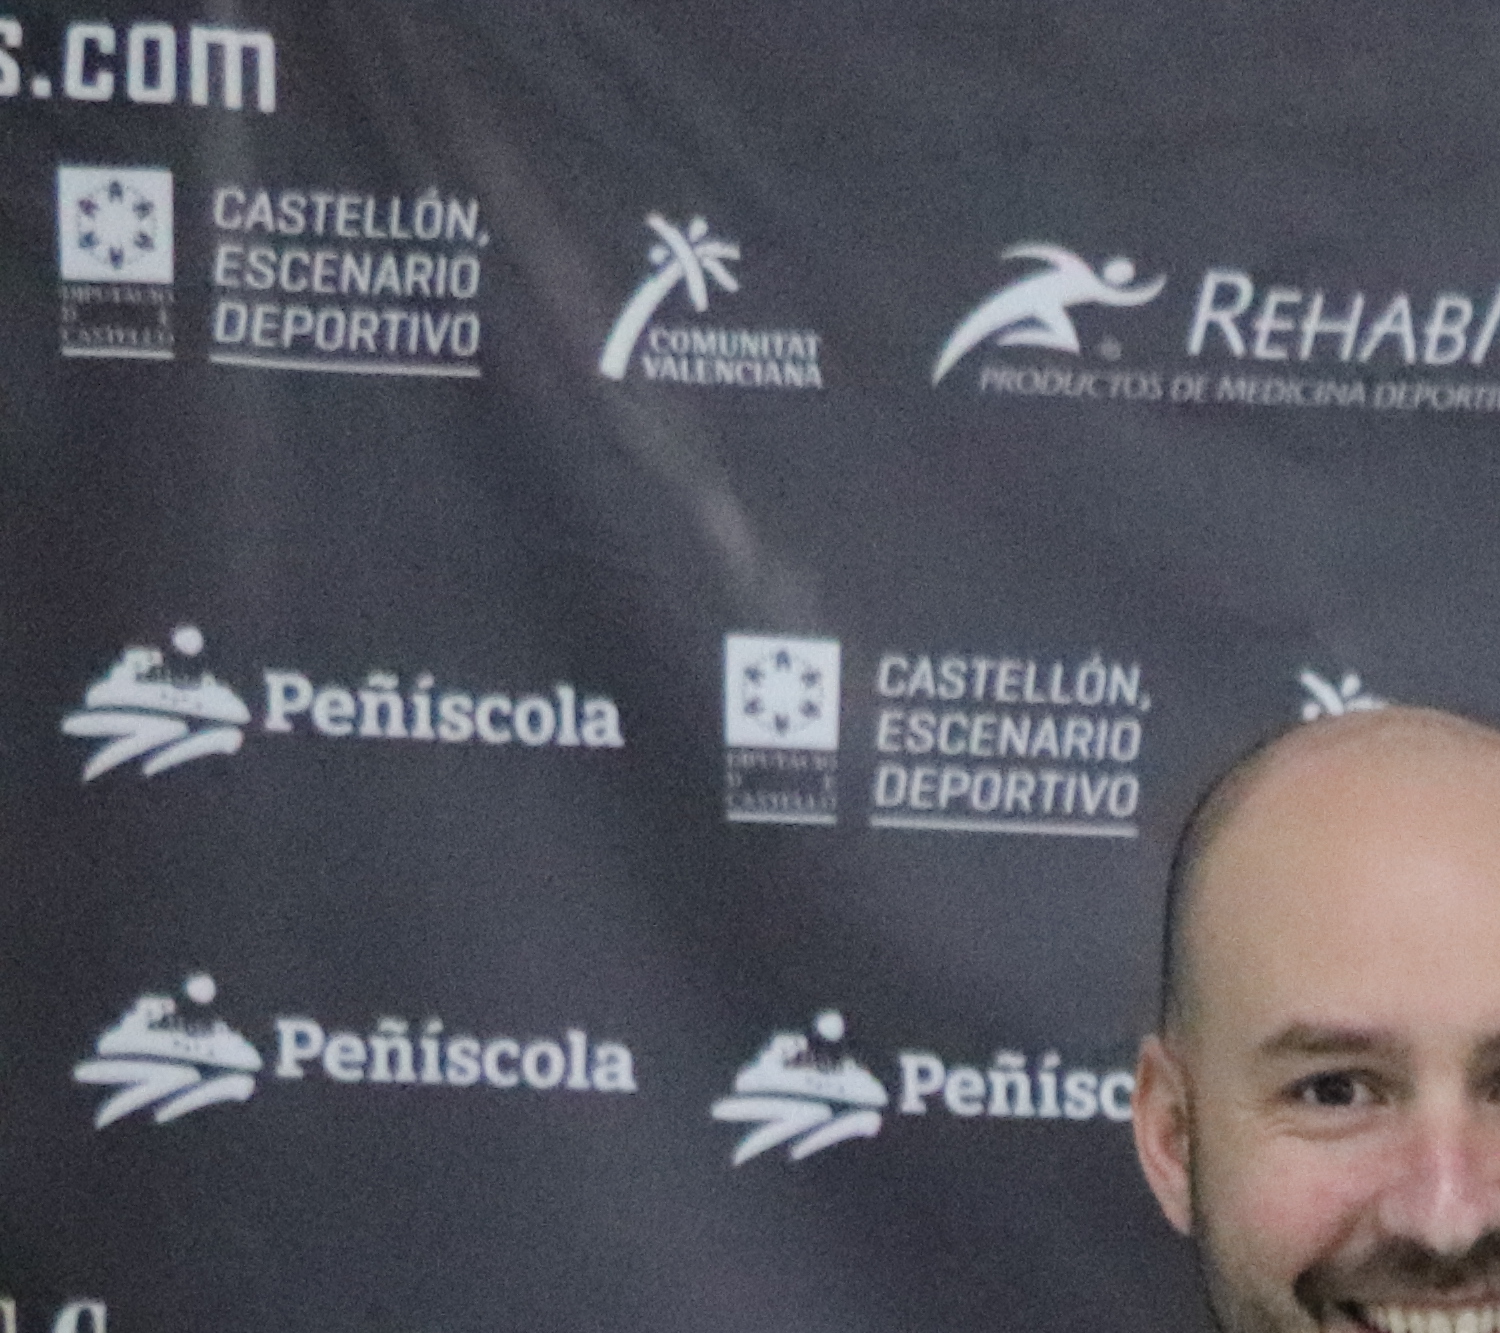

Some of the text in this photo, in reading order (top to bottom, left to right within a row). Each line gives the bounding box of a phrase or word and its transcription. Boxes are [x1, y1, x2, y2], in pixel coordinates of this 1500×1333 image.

[212, 186, 490, 248] CASTELLÓN,
[213, 246, 480, 299] ESCENARIO
[214, 302, 480, 356] DEPORTIVO
[649, 326, 820, 358] COMUNITAT
[642, 356, 824, 389] VALENCIANA
[875, 652, 1152, 710] CASTELLÓN,
[262, 668, 626, 750] Peñíscola
[874, 709, 1142, 763] ESCENARIO
[872, 765, 1140, 818] DEPORTIVO
[275, 1016, 639, 1094] Peñíscola
[898, 1050, 1135, 1123] Peñísc
